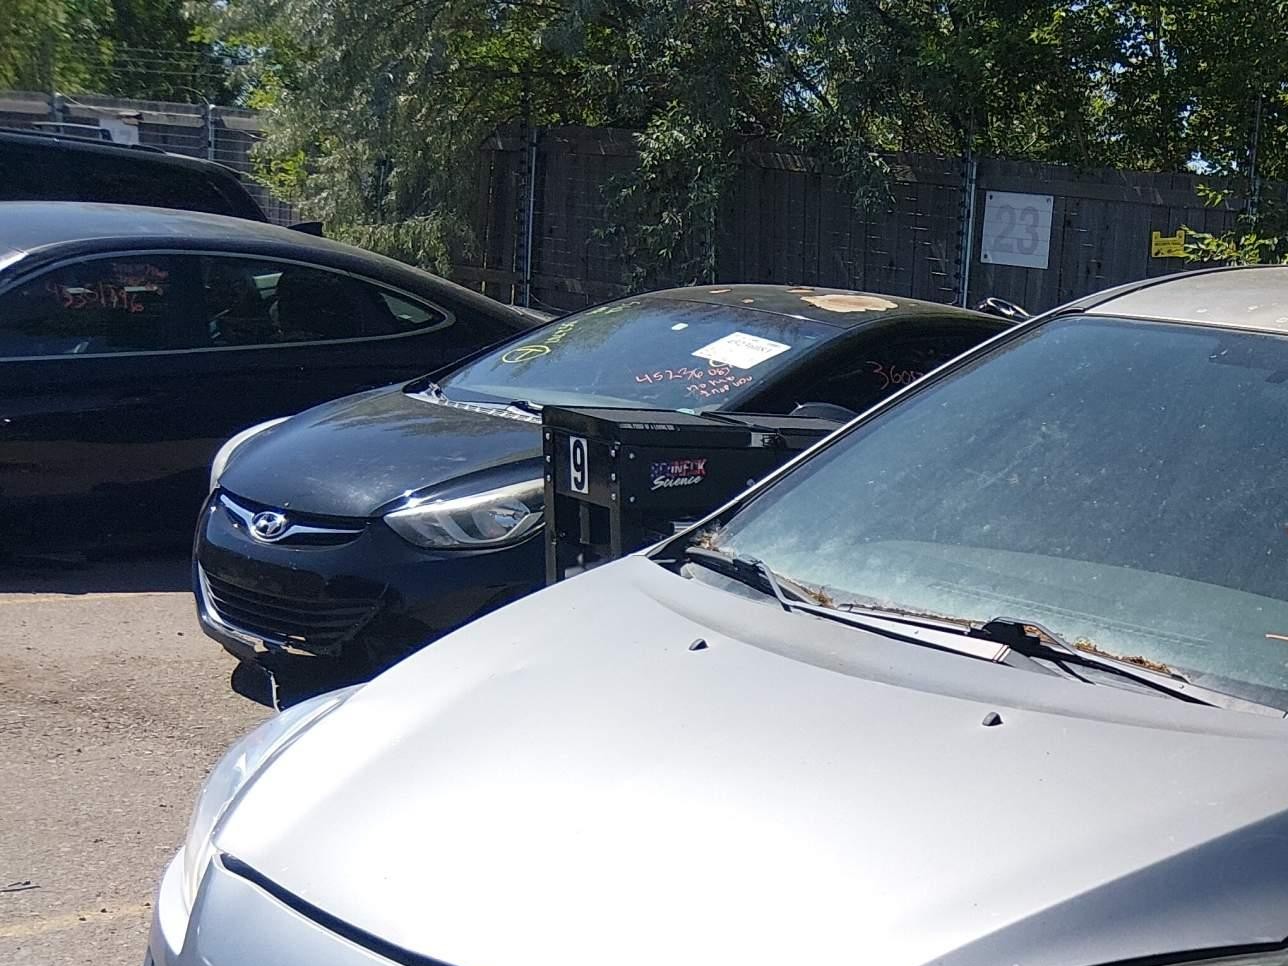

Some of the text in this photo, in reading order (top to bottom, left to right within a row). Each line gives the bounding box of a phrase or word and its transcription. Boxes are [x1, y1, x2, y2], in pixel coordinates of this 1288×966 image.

[992, 204, 1041, 256] 23
[572, 438, 586, 491] 9
[650, 475, 703, 491] Science
